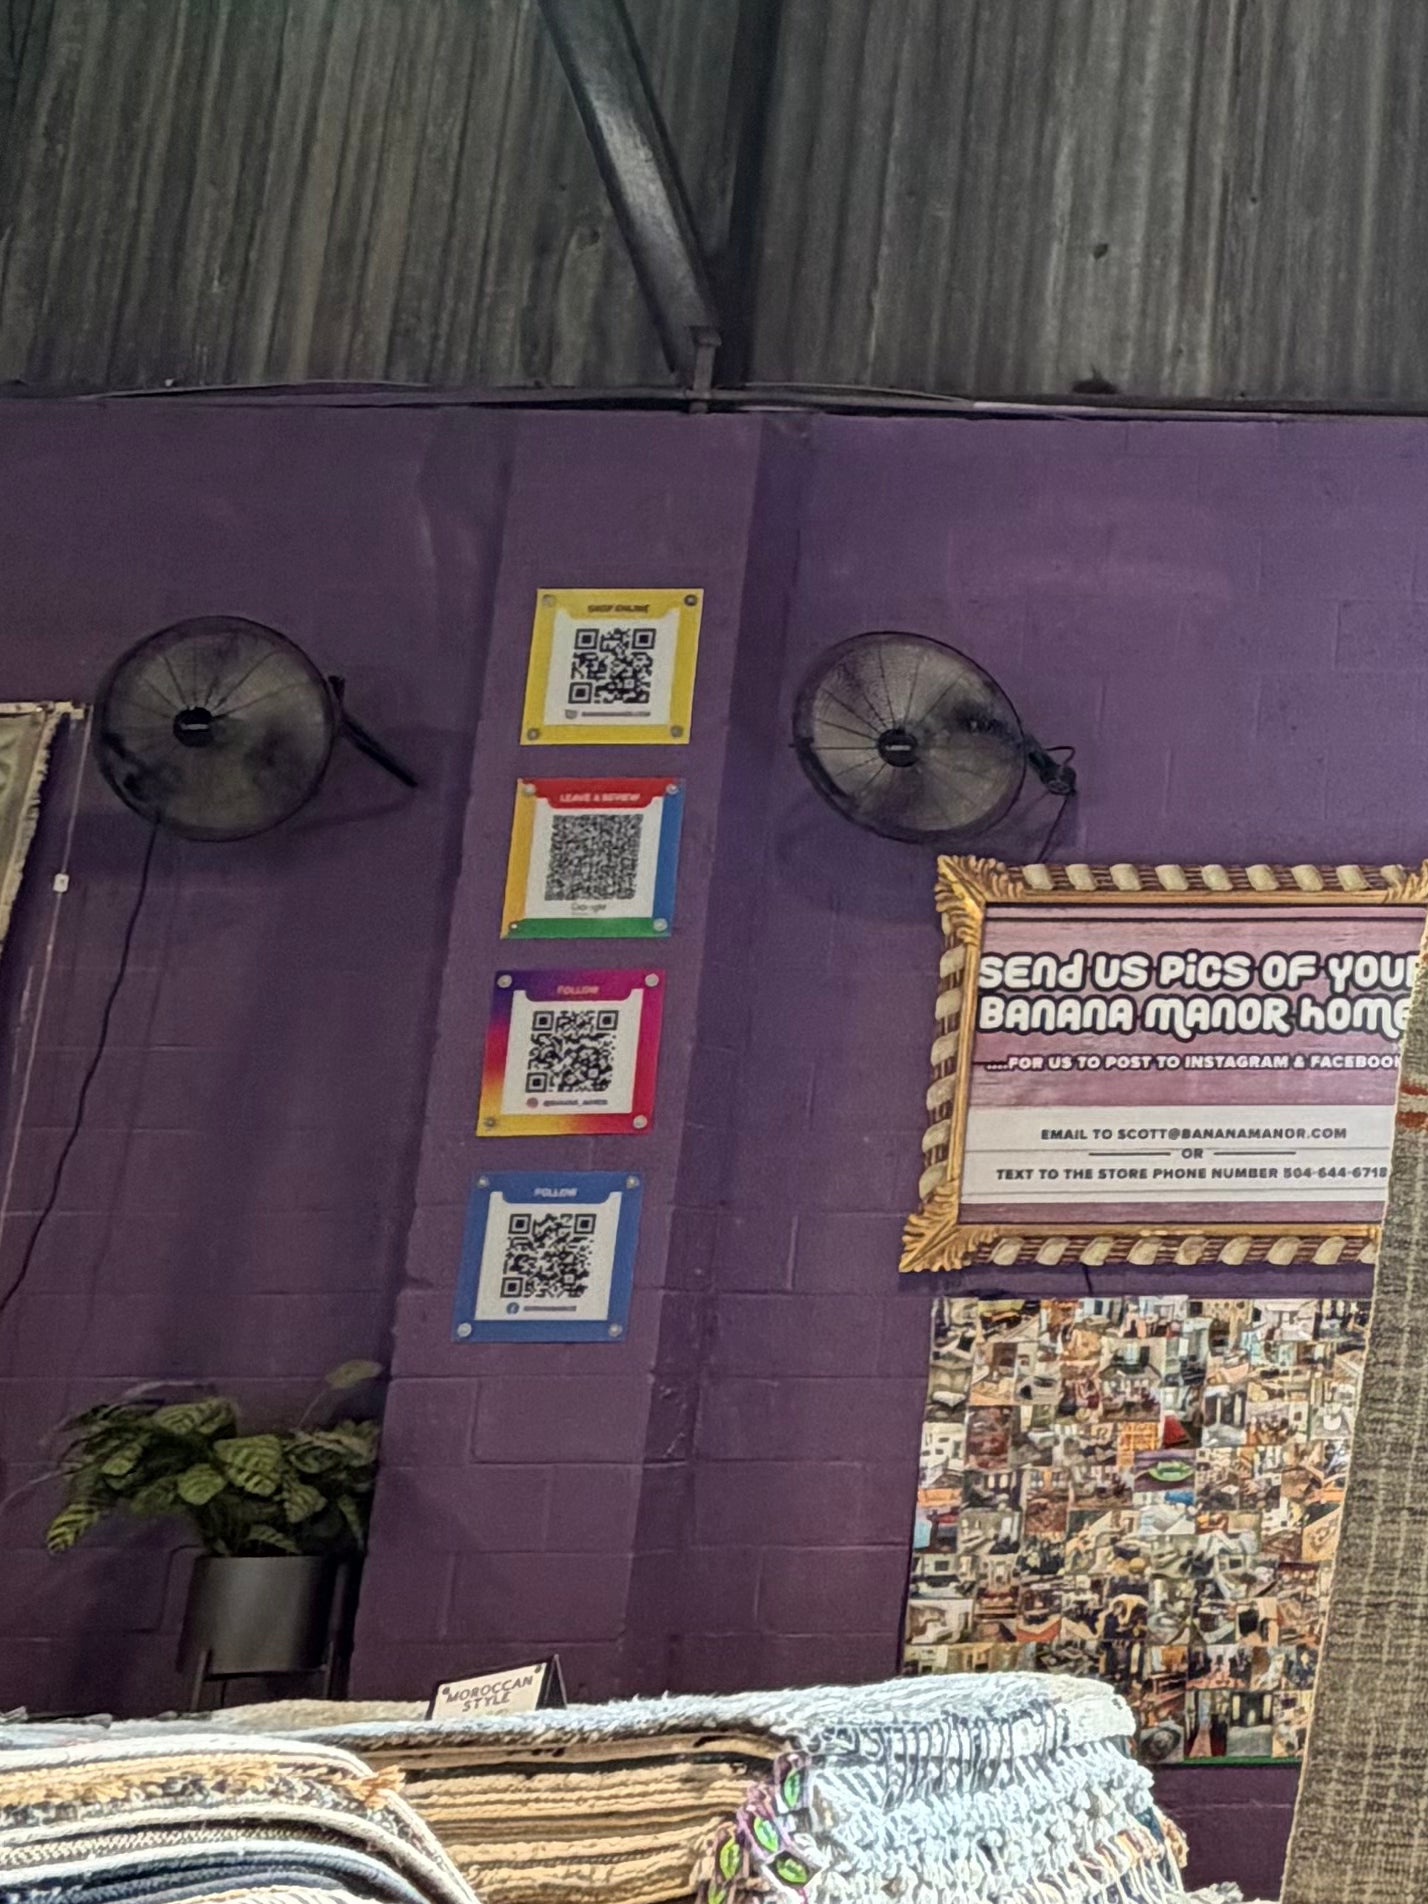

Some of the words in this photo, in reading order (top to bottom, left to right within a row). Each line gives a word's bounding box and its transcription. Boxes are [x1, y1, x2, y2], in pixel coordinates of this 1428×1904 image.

[1094, 955, 1150, 988] US
[1261, 955, 1318, 988] OF
[1048, 1055, 1073, 1069] US
[1077, 1055, 1100, 1069] TO
[1105, 1055, 1152, 1069] POST
[1156, 1055, 1181, 1068] TO
[1184, 1054, 1289, 1069] INSTAGRAM
[1293, 1055, 1305, 1069] &
[1040, 1128, 1088, 1140] EMAIL
[1092, 1128, 1113, 1140] TO
[1117, 1127, 1347, 1140] SCOTT@BANANAMANOR.COM
[1181, 1148, 1204, 1159] OR
[996, 1168, 1034, 1180] TEXT
[1039, 1168, 1059, 1180] TO
[1063, 1168, 1093, 1180] THE
[1098, 1168, 1148, 1179] STORE
[1152, 1167, 1207, 1179] PHONE
[1211, 1167, 1278, 1179] NUMBER
[446, 1675, 534, 1703] MOROCCAN
[461, 1691, 511, 1712] STYLE
